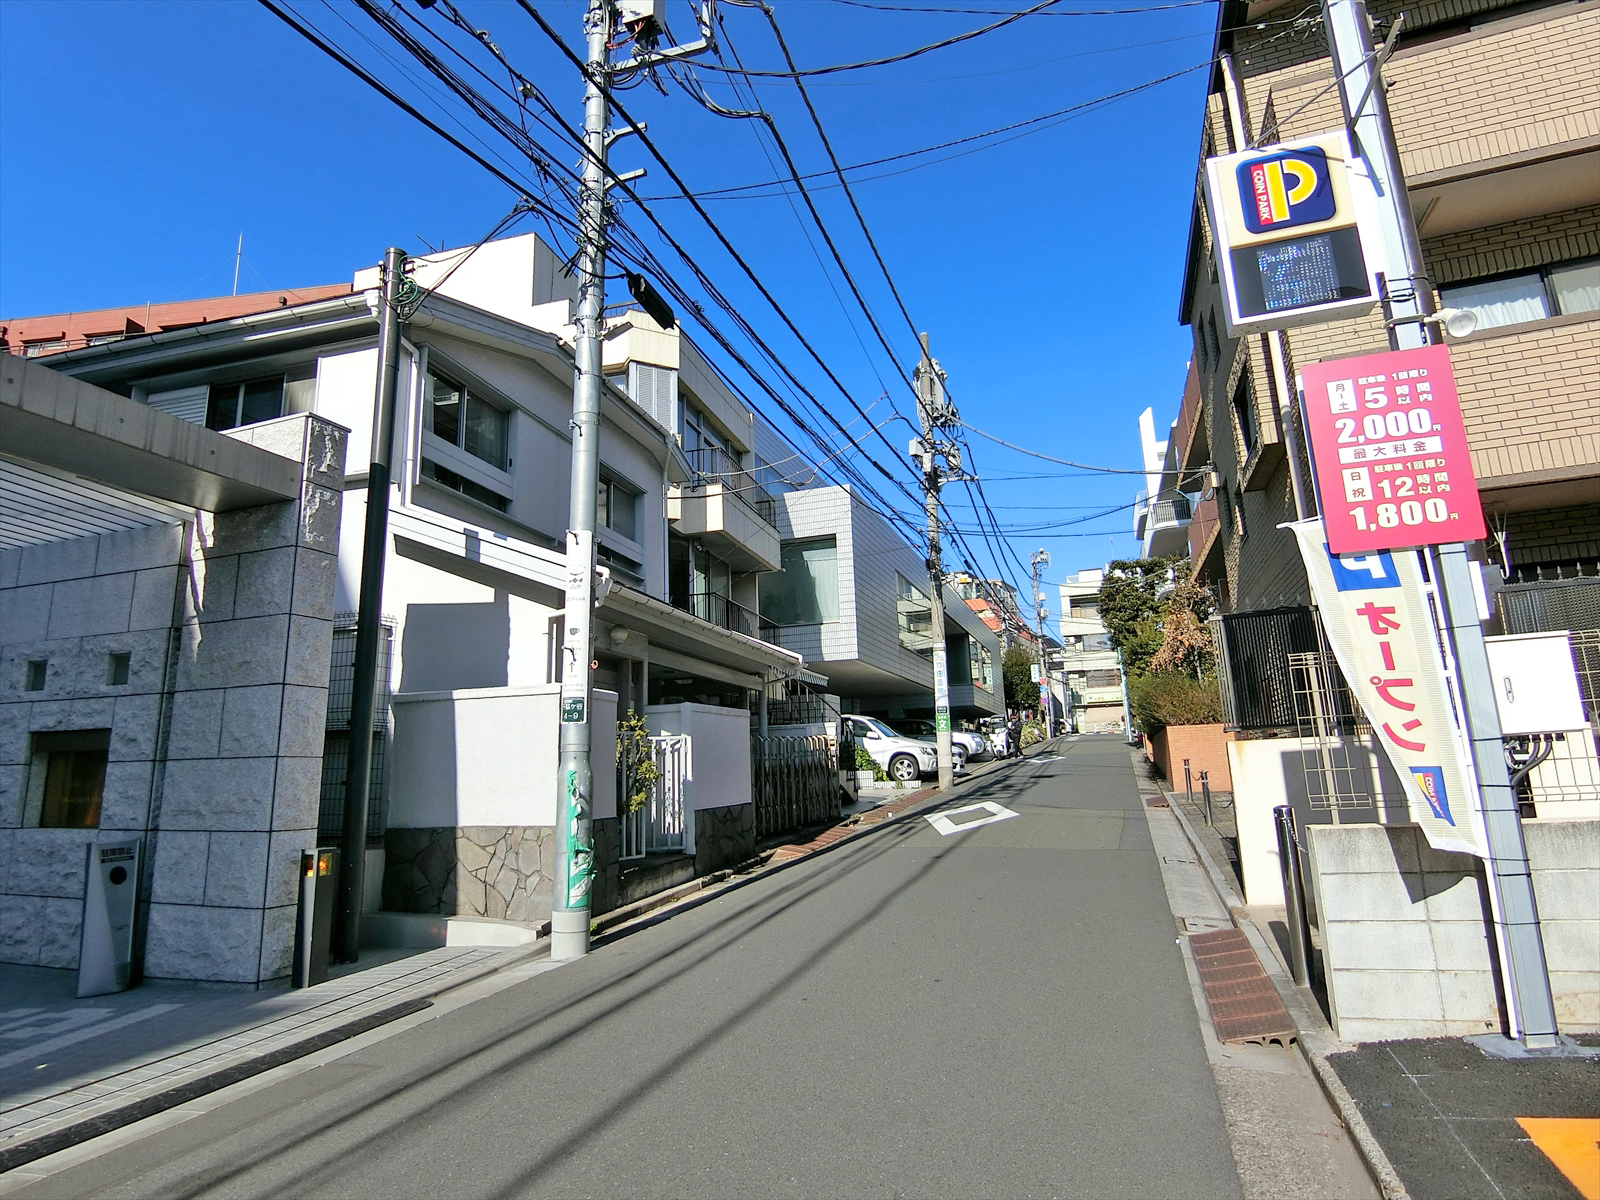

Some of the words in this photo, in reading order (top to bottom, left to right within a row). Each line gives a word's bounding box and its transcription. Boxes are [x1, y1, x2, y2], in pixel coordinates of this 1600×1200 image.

[1253, 169, 1267, 195] COIN
[1257, 194, 1272, 221] PARK
[1363, 385, 1389, 410] 5
[1353, 440, 1428, 460] 最大料金
